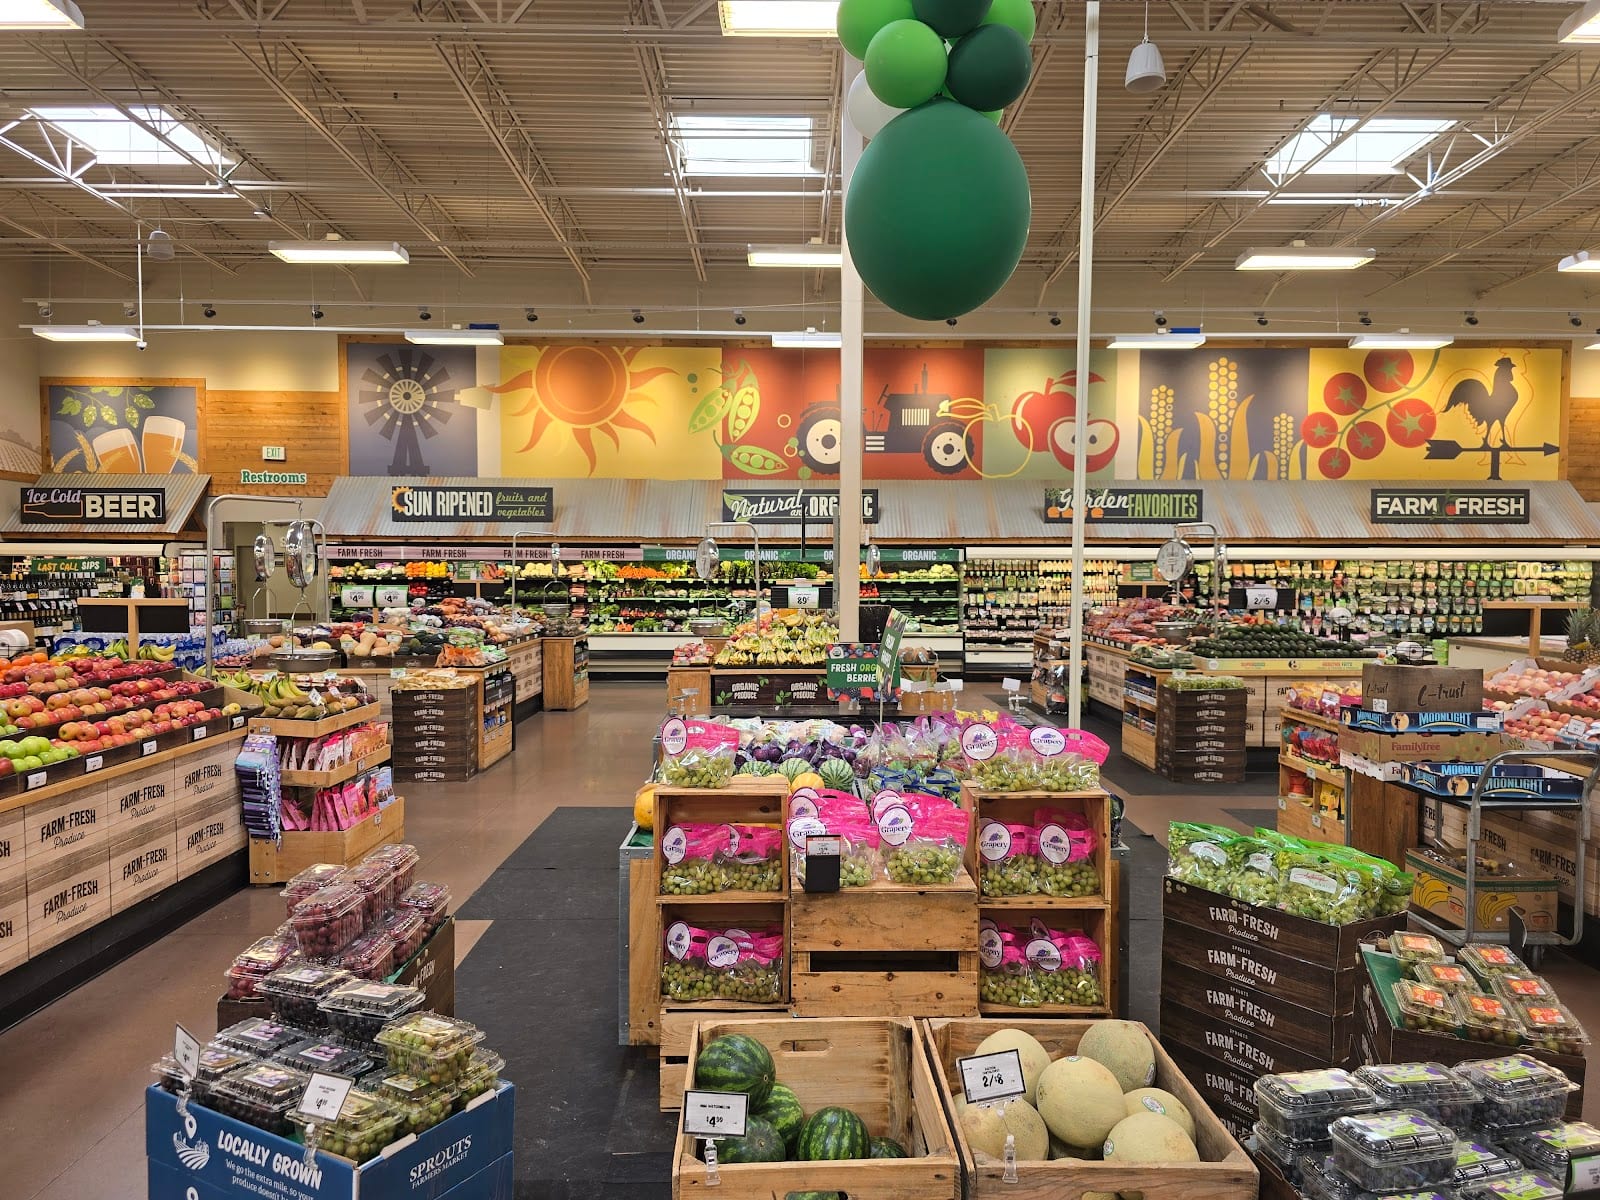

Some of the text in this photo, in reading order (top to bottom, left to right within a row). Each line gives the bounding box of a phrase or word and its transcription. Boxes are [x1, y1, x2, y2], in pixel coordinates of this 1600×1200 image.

[267, 448, 281, 458] EXIT
[241, 470, 306, 484] Restrooms
[27, 489, 81, 504] Ice Cold
[404, 491, 493, 516] SUN RIPENED
[496, 492, 547, 504] fruits and
[730, 489, 803, 520] Natural
[809, 496, 873, 516] ORGC
[1057, 488, 1129, 511] Grden
[1128, 494, 1197, 517] FAVORITES
[1377, 497, 1524, 515] FARM FRESH
[86, 495, 157, 518] BEER
[497, 506, 545, 519] vegetables
[338, 549, 383, 557] FARM FRESH
[422, 549, 466, 558] FARM FRESH
[504, 550, 548, 558] FAM FRESH
[581, 551, 624, 559] FARM FRESH
[666, 550, 697, 560] ORGANI
[903, 550, 936, 561] ORGANIC
[38, 561, 100, 572] LAST CALL SIPS
[831, 664, 857, 672] FRESH
[732, 683, 759, 692] ORGANIC
[791, 682, 818, 692] ORGANIC
[847, 674, 877, 682] BERRIE
[1419, 712, 1471, 726] MOONLIGHT
[966, 740, 994, 751] Grapery
[1033, 737, 1063, 747] Grapery
[185, 765, 222, 789] FARM-FRESH
[120, 785, 165, 813] FARM-FRESH
[130, 803, 156, 820] Produce
[41, 809, 96, 842] FARM-FRESH
[881, 824, 909, 834] Grapery
[53, 830, 85, 850] Produce
[187, 822, 224, 850] FARM-FRESH
[980, 839, 1008, 849] Grapery
[1043, 841, 1070, 852] Grapery
[123, 848, 168, 881] FARM-FRESH
[1530, 848, 1576, 877] FARM-FRES
[133, 867, 159, 886] Produce
[44, 880, 98, 918] FARM-FRESH
[56, 902, 87, 925] Produce
[1209, 906, 1279, 940] FARM-FRESH
[1228, 924, 1260, 942] Produce
[1207, 949, 1277, 985] FARM-FRESH
[1225, 967, 1257, 986] Produce
[1206, 989, 1275, 1027] FARM-FRESH
[1225, 1009, 1255, 1027] Produce
[1205, 1031, 1274, 1071] FARM-FRESH
[1223, 1051, 1254, 1070] Produce
[1206, 1073, 1258, 1106] FARM-FRE
[1223, 1094, 1254, 1114] Produce
[218, 1130, 323, 1190] LOCALLY GROWN
[409, 1134, 472, 1182] SPROUTS
[226, 1159, 236, 1170] We
[236, 1166, 244, 1174] go
[245, 1167, 255, 1179] the
[256, 1173, 272, 1186] extra
[273, 1181, 289, 1194] mile,
[290, 1188, 297, 1196] so
[412, 1150, 469, 1190] FARMERS MARKET
[232, 1175, 257, 1192] produce
